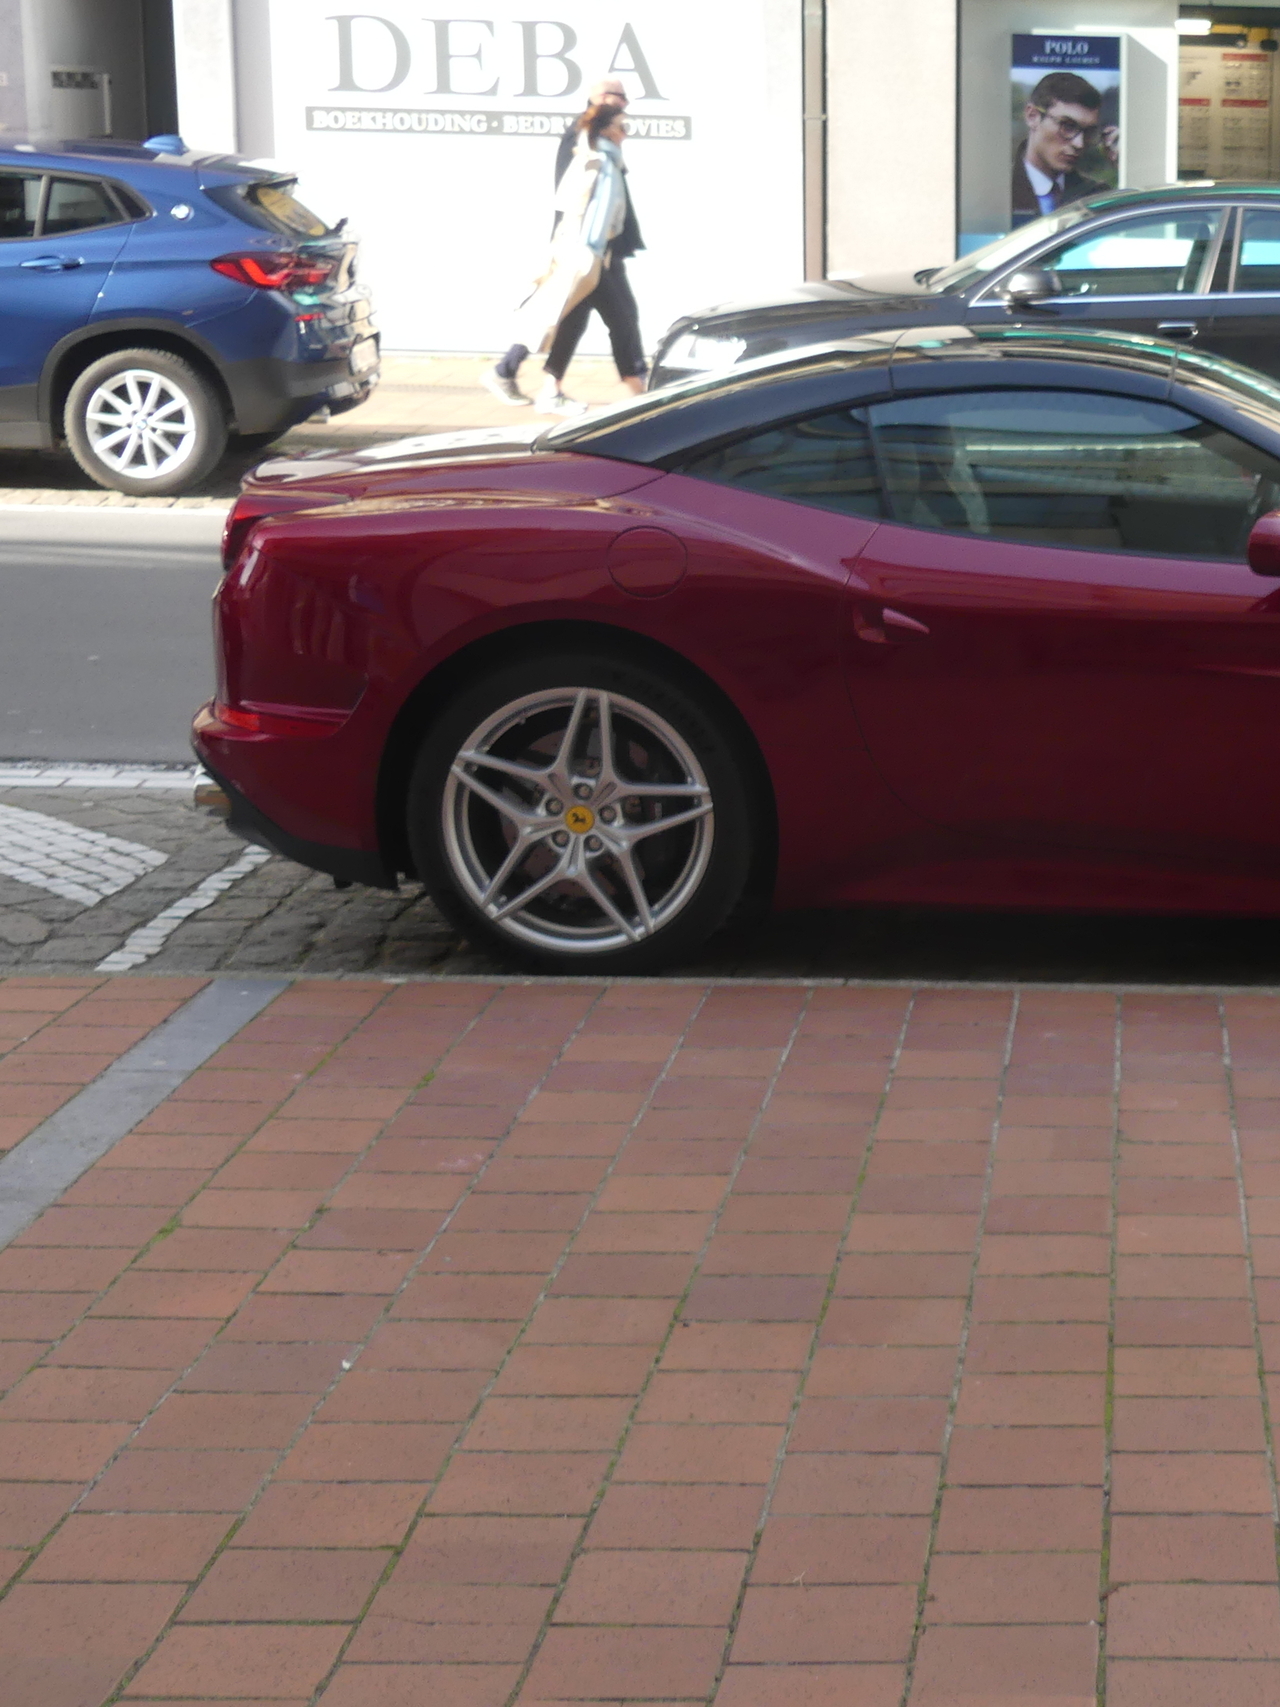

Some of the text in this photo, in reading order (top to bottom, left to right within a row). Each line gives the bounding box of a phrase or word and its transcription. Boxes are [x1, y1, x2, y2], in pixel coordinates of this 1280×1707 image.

[325, 15, 670, 101] DEBA
[1044, 39, 1090, 55] POLO
[312, 110, 488, 133] BOEKHOUDING
